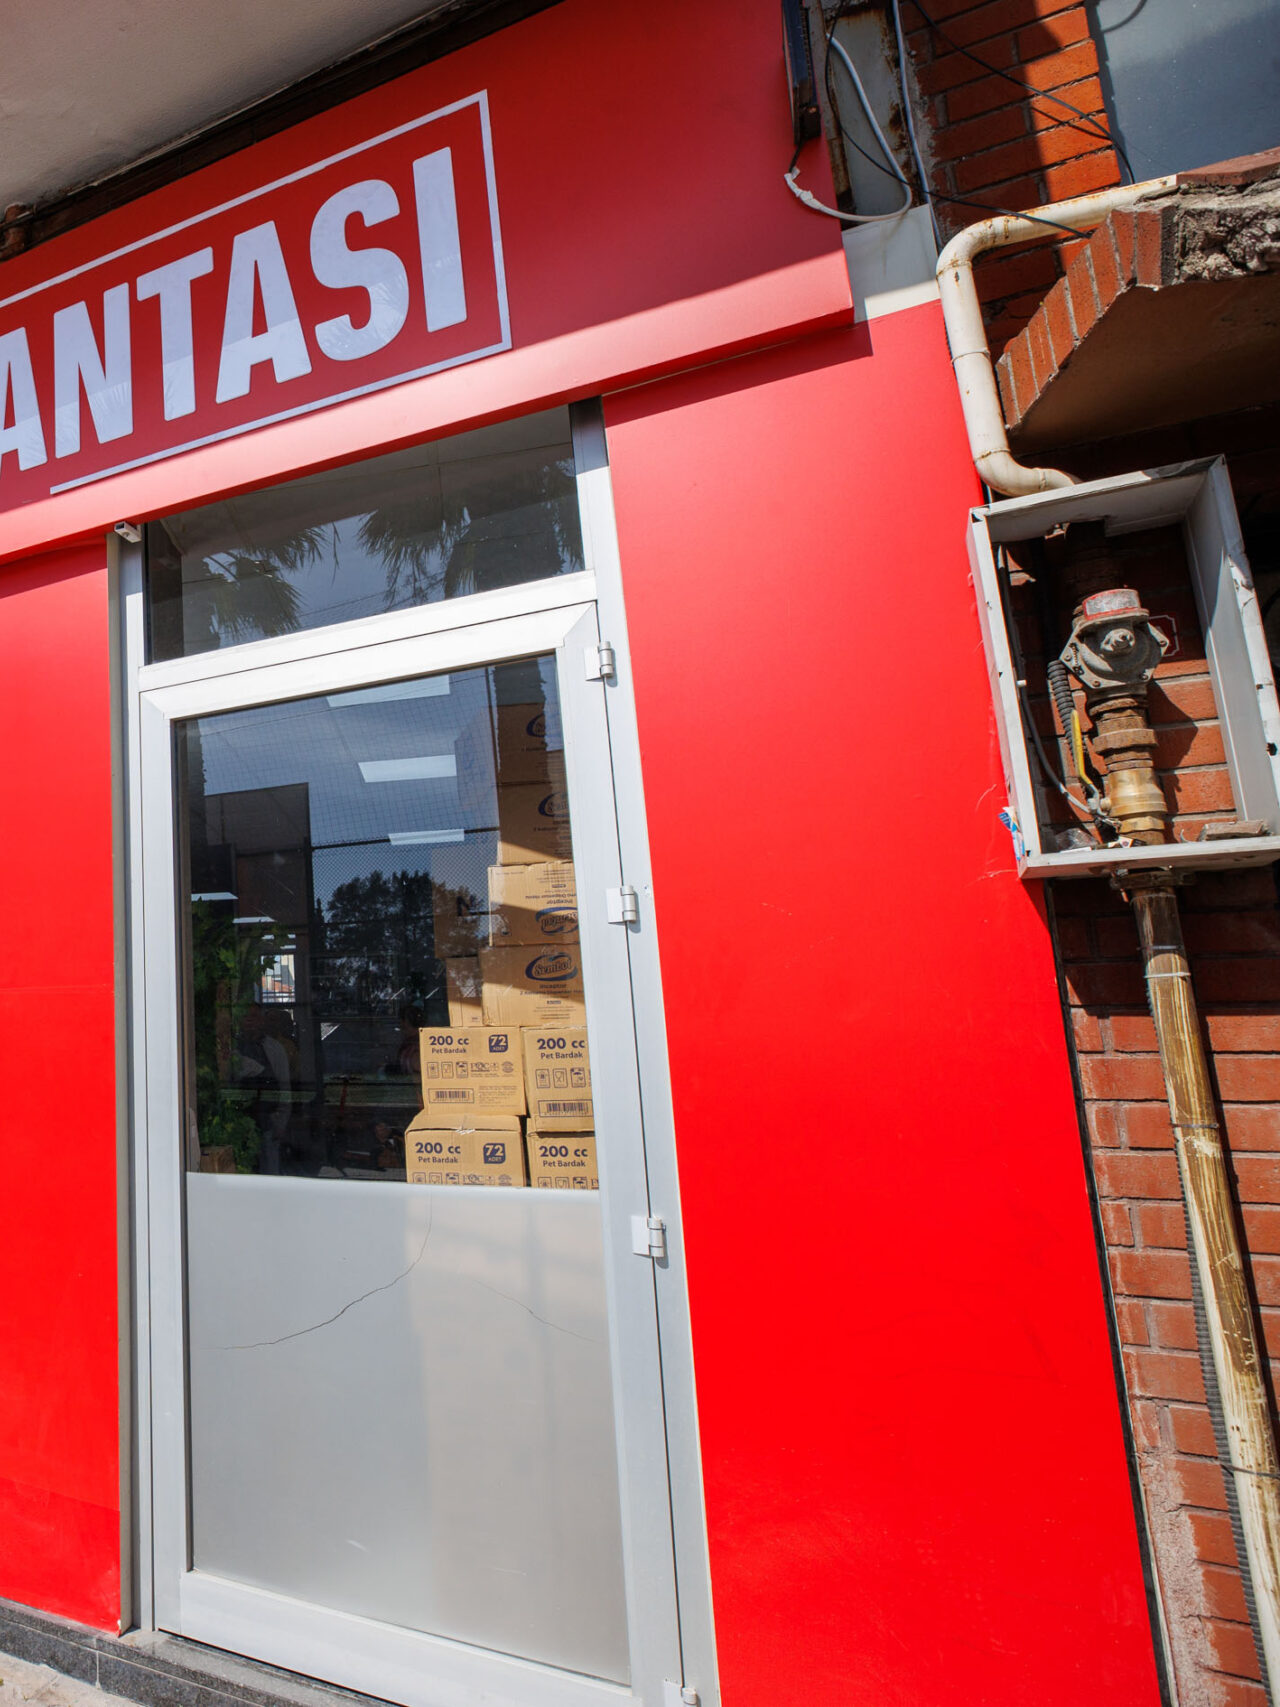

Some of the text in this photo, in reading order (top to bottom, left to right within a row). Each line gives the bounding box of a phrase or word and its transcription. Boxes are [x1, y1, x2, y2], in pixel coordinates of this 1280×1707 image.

[428, 1035, 469, 1046] 200 cc
[490, 1035, 507, 1047] 72
[536, 1037, 586, 1050] 200 cc
[540, 1051, 584, 1060] Pet Bardak
[415, 1142, 461, 1154] 200 cc
[485, 1144, 504, 1157] 72
[539, 1145, 589, 1158] 200 cc
[432, 1156, 459, 1164] Bardak
[542, 1159, 586, 1168] Pet Bardak
